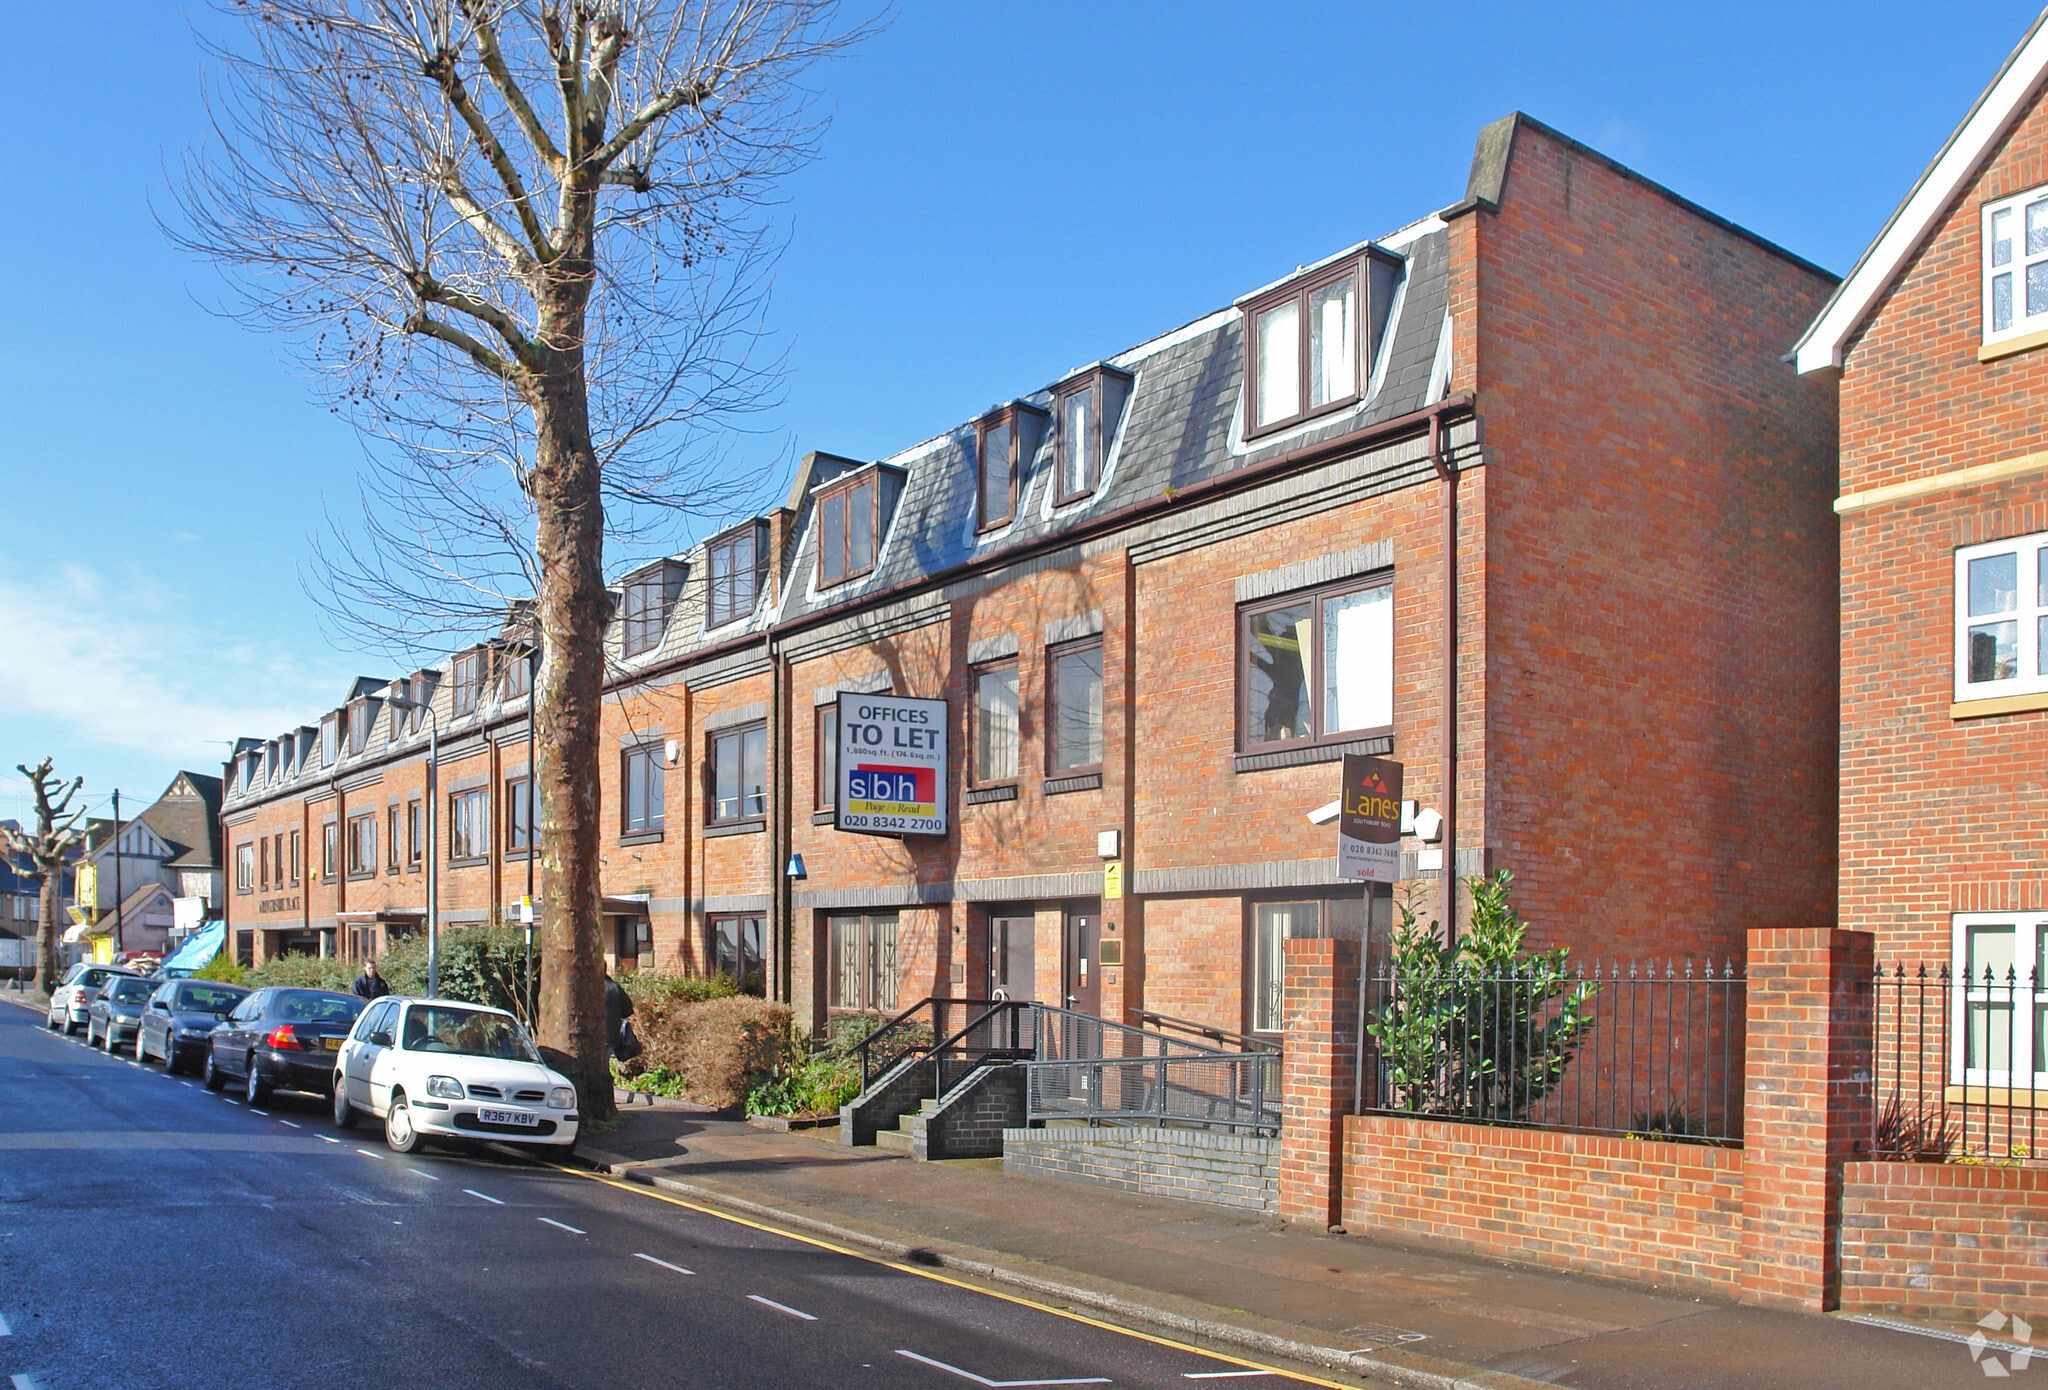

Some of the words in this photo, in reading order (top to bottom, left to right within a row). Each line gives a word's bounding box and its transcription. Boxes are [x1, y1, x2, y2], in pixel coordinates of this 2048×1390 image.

[859, 706, 928, 724] OFFICES
[847, 723, 883, 746] TO
[893, 726, 939, 750] LET
[850, 773, 914, 801] sbh
[865, 802, 885, 813] Page
[897, 804, 920, 814] Read
[1345, 788, 1400, 820] Lanes
[844, 815, 868, 827] 020
[873, 817, 906, 829] 8342
[911, 818, 942, 830] 2700
[1350, 845, 1364, 854] 020
[1357, 868, 1374, 877] sold
[484, 1110, 512, 1122] R367
[514, 1114, 534, 1125] KBV
